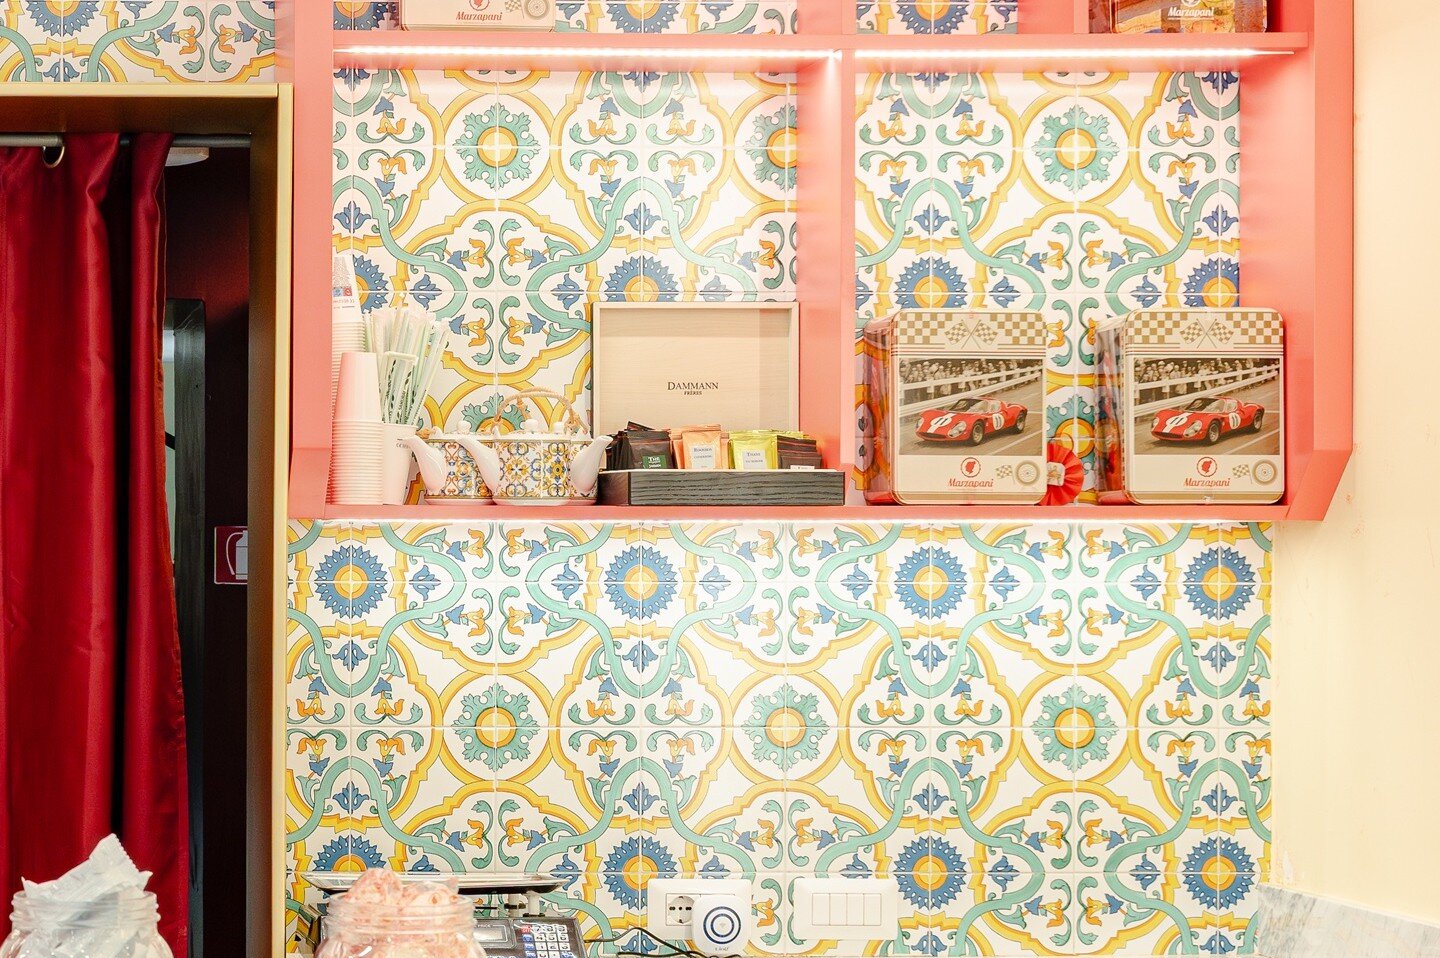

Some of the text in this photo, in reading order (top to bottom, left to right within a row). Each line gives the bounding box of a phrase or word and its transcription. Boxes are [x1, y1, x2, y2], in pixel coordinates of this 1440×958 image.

[456, 12, 502, 21] Marzapani
[1168, 7, 1214, 18] Marzapani
[668, 382, 719, 391] DAMMANN
[948, 478, 994, 488] Marzapani
[1184, 478, 1230, 488] Marzapani
